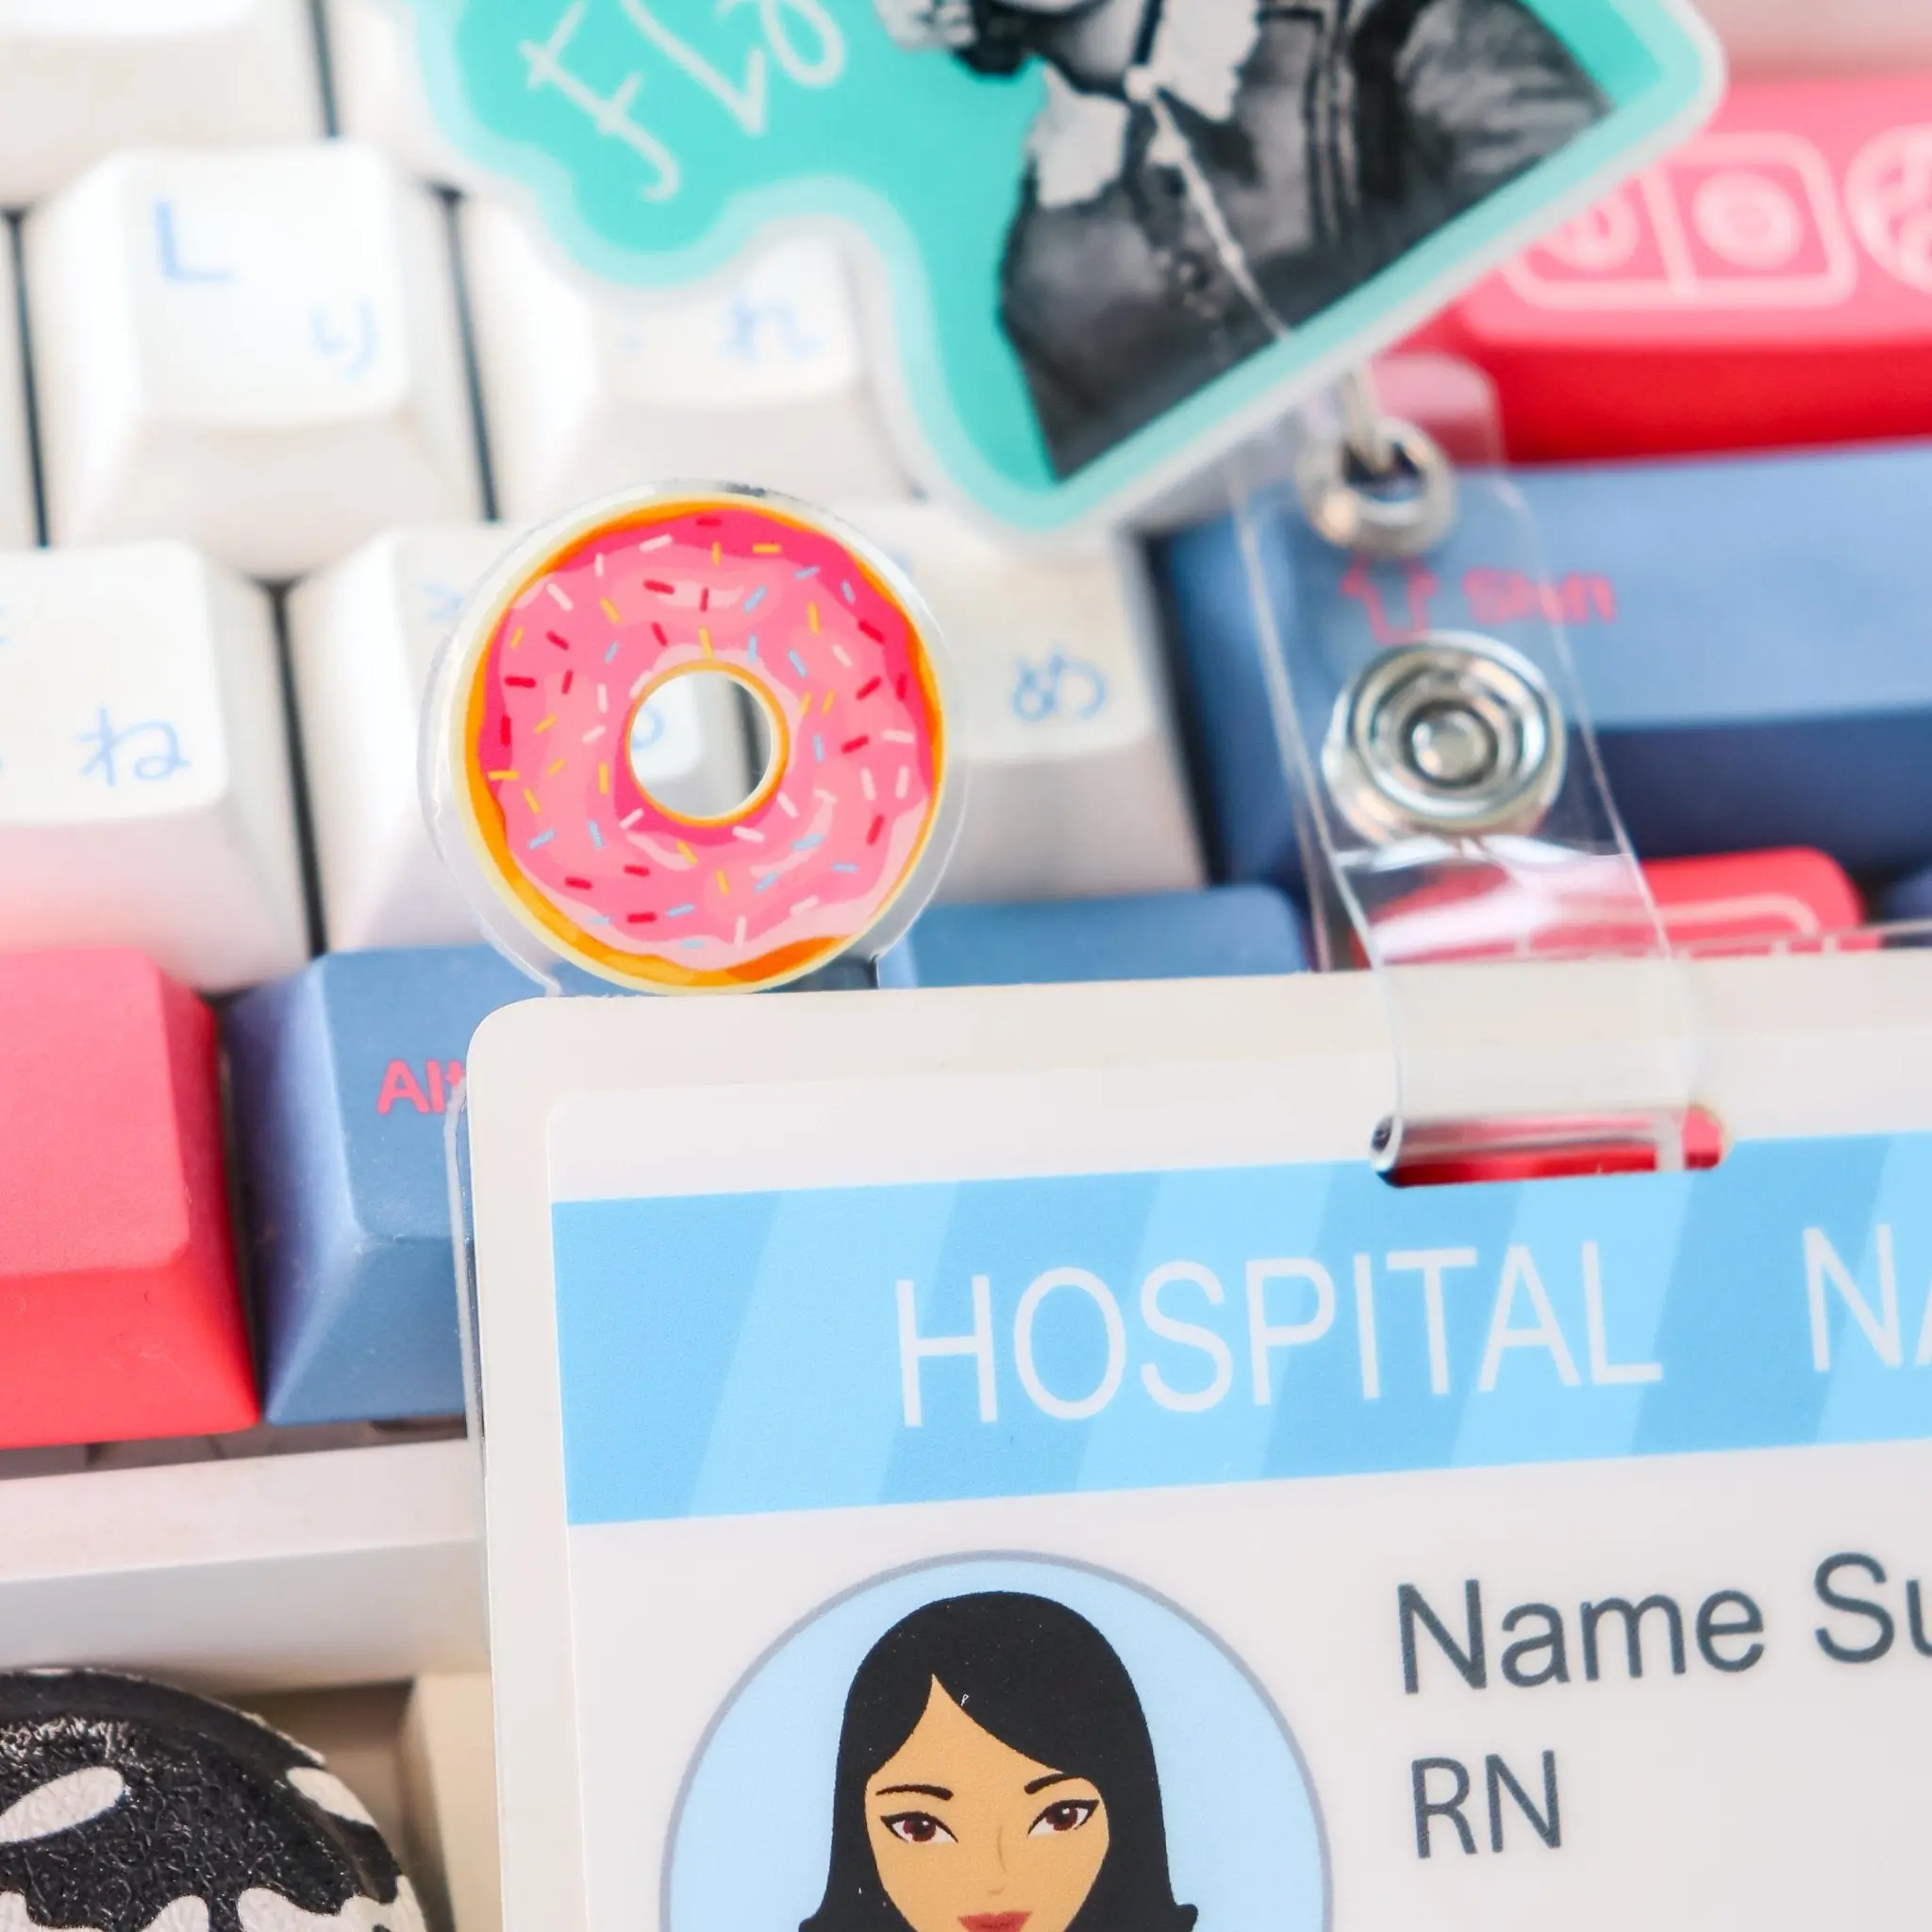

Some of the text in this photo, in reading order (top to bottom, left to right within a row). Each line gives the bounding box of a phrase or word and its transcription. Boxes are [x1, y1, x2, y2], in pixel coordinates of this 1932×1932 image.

[155, 194, 234, 283] L
[1013, 645, 1108, 723] め
[75, 705, 191, 787] ね
[896, 1224, 1932, 1427] HOSPITAL N
[1397, 1578, 1765, 1695] Name
[1410, 1749, 1562, 1859] RN
